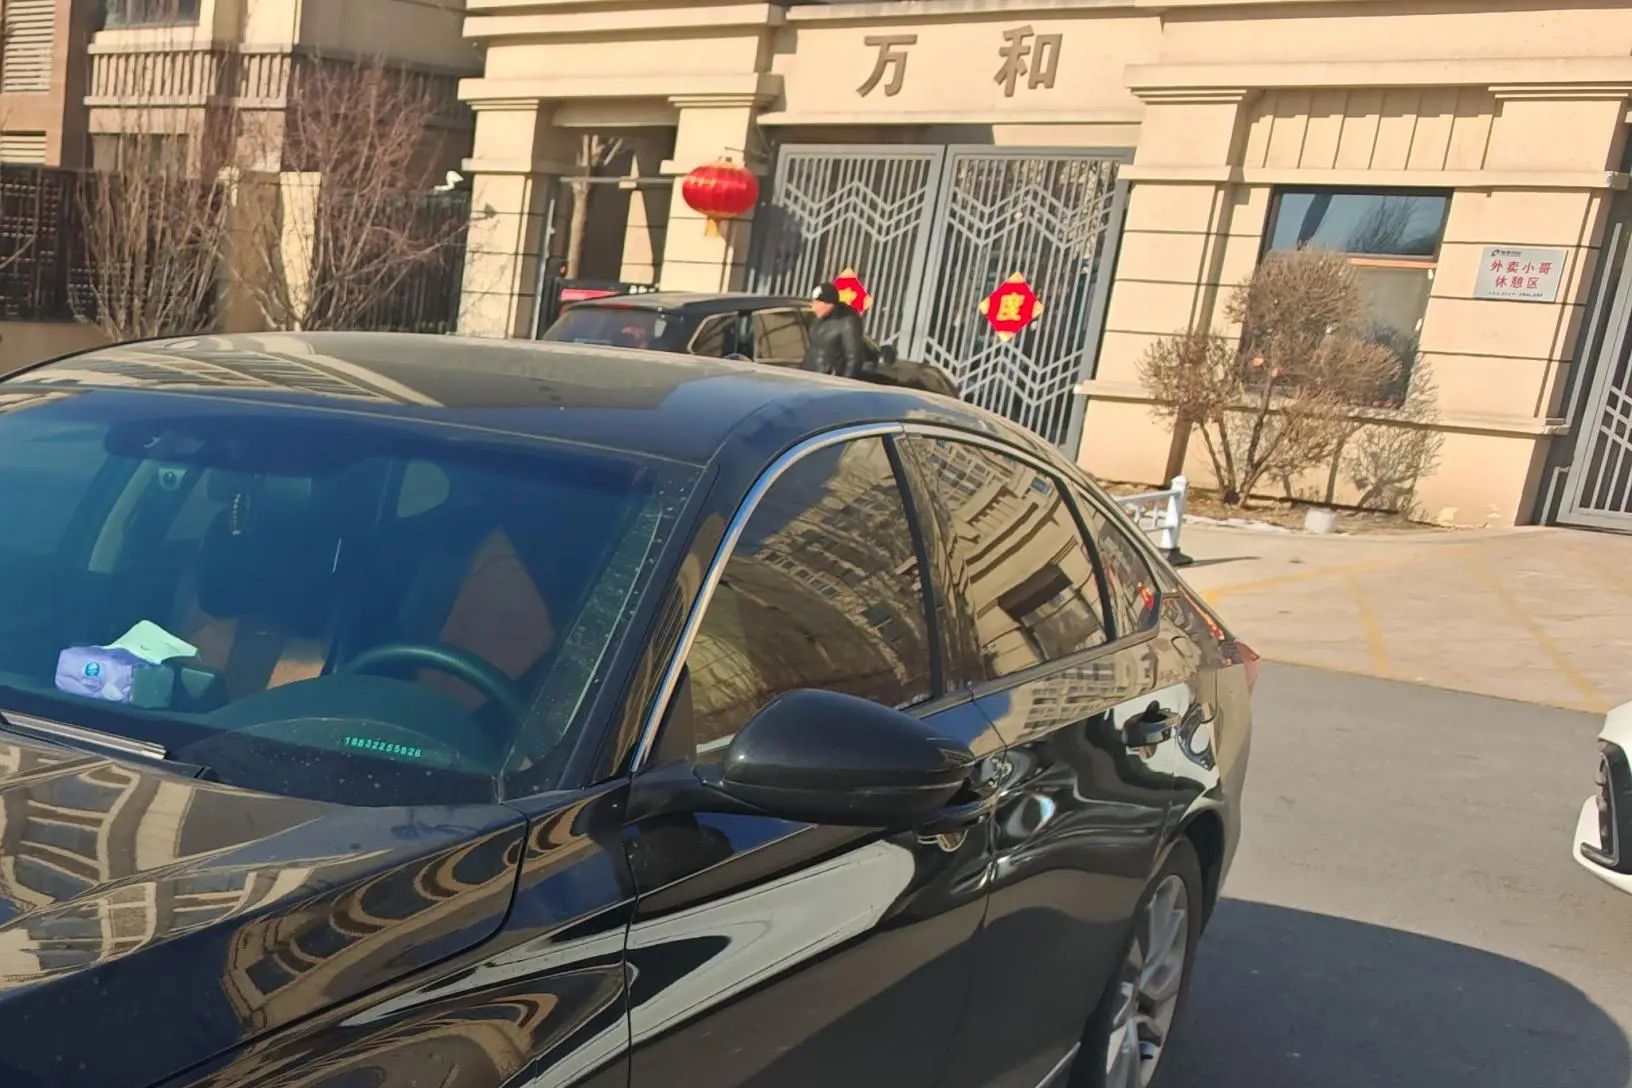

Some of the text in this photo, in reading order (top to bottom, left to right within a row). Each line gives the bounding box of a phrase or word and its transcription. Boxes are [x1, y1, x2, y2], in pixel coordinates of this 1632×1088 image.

[855, 24, 1063, 98] 万和
[1489, 259, 1552, 275] 外卖小哥
[1494, 275, 1540, 289] 休憩区
